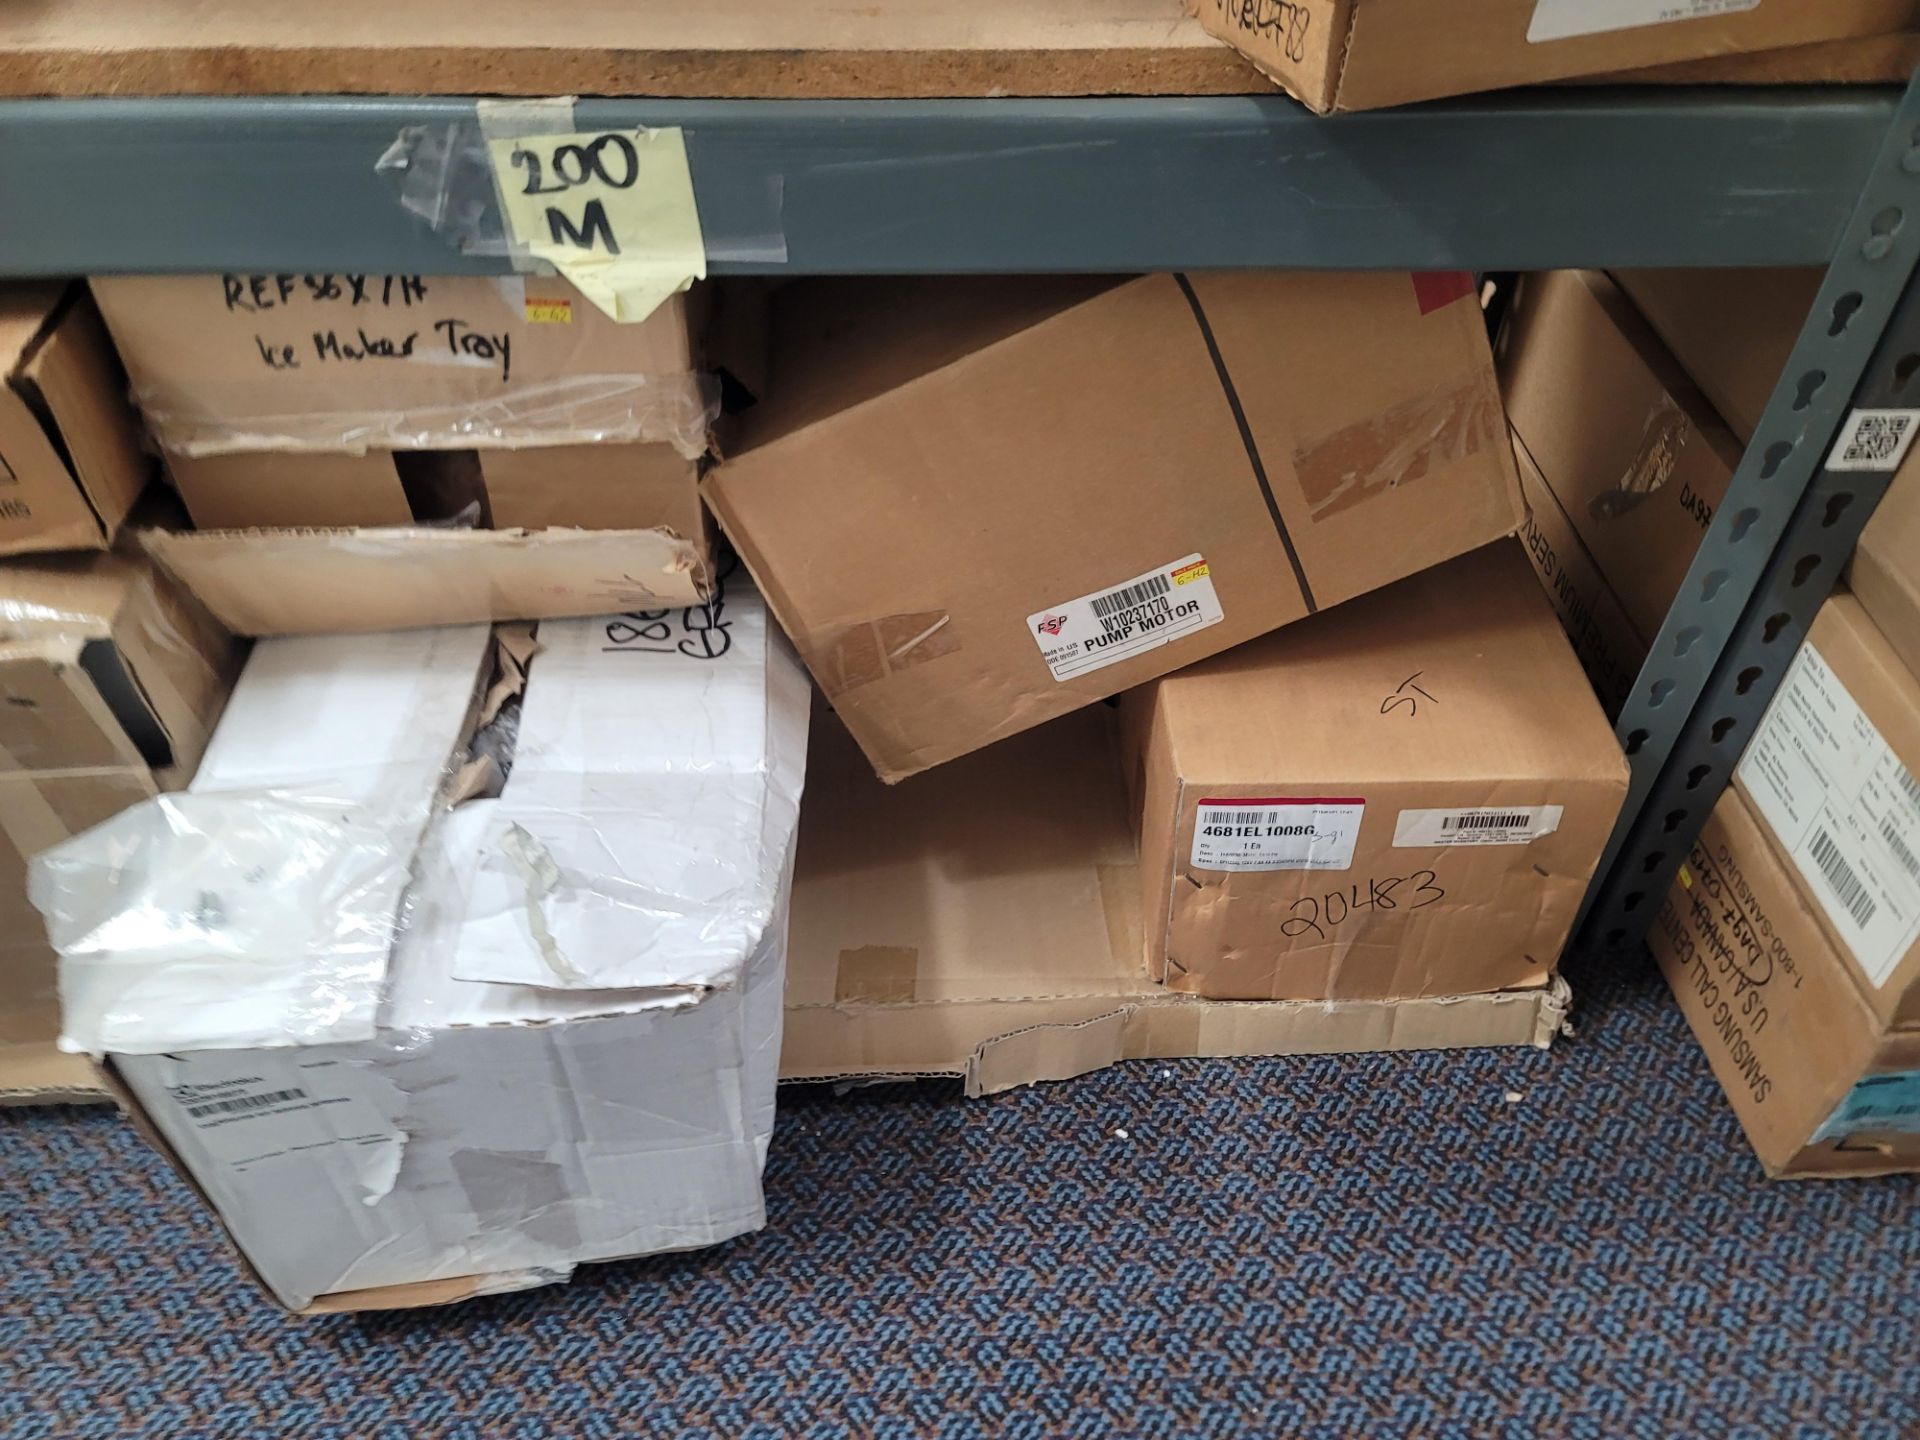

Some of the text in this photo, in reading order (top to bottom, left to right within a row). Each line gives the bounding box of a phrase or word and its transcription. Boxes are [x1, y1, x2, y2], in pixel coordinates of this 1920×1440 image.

[511, 134, 639, 194] 200
[545, 198, 621, 255] M
[1037, 614, 1068, 635] FSP
[1084, 599, 1200, 652] PUMP MOTOR
[1100, 596, 1169, 632] W10237170
[1202, 825, 1316, 838] 4681EL1008G
[1281, 870, 1445, 939] 20483
[1718, 845, 1804, 990] 1-800-SAMSUNG
[1690, 959, 1720, 1009] CALL
[1712, 1001, 1772, 1104] SAMSUNG
